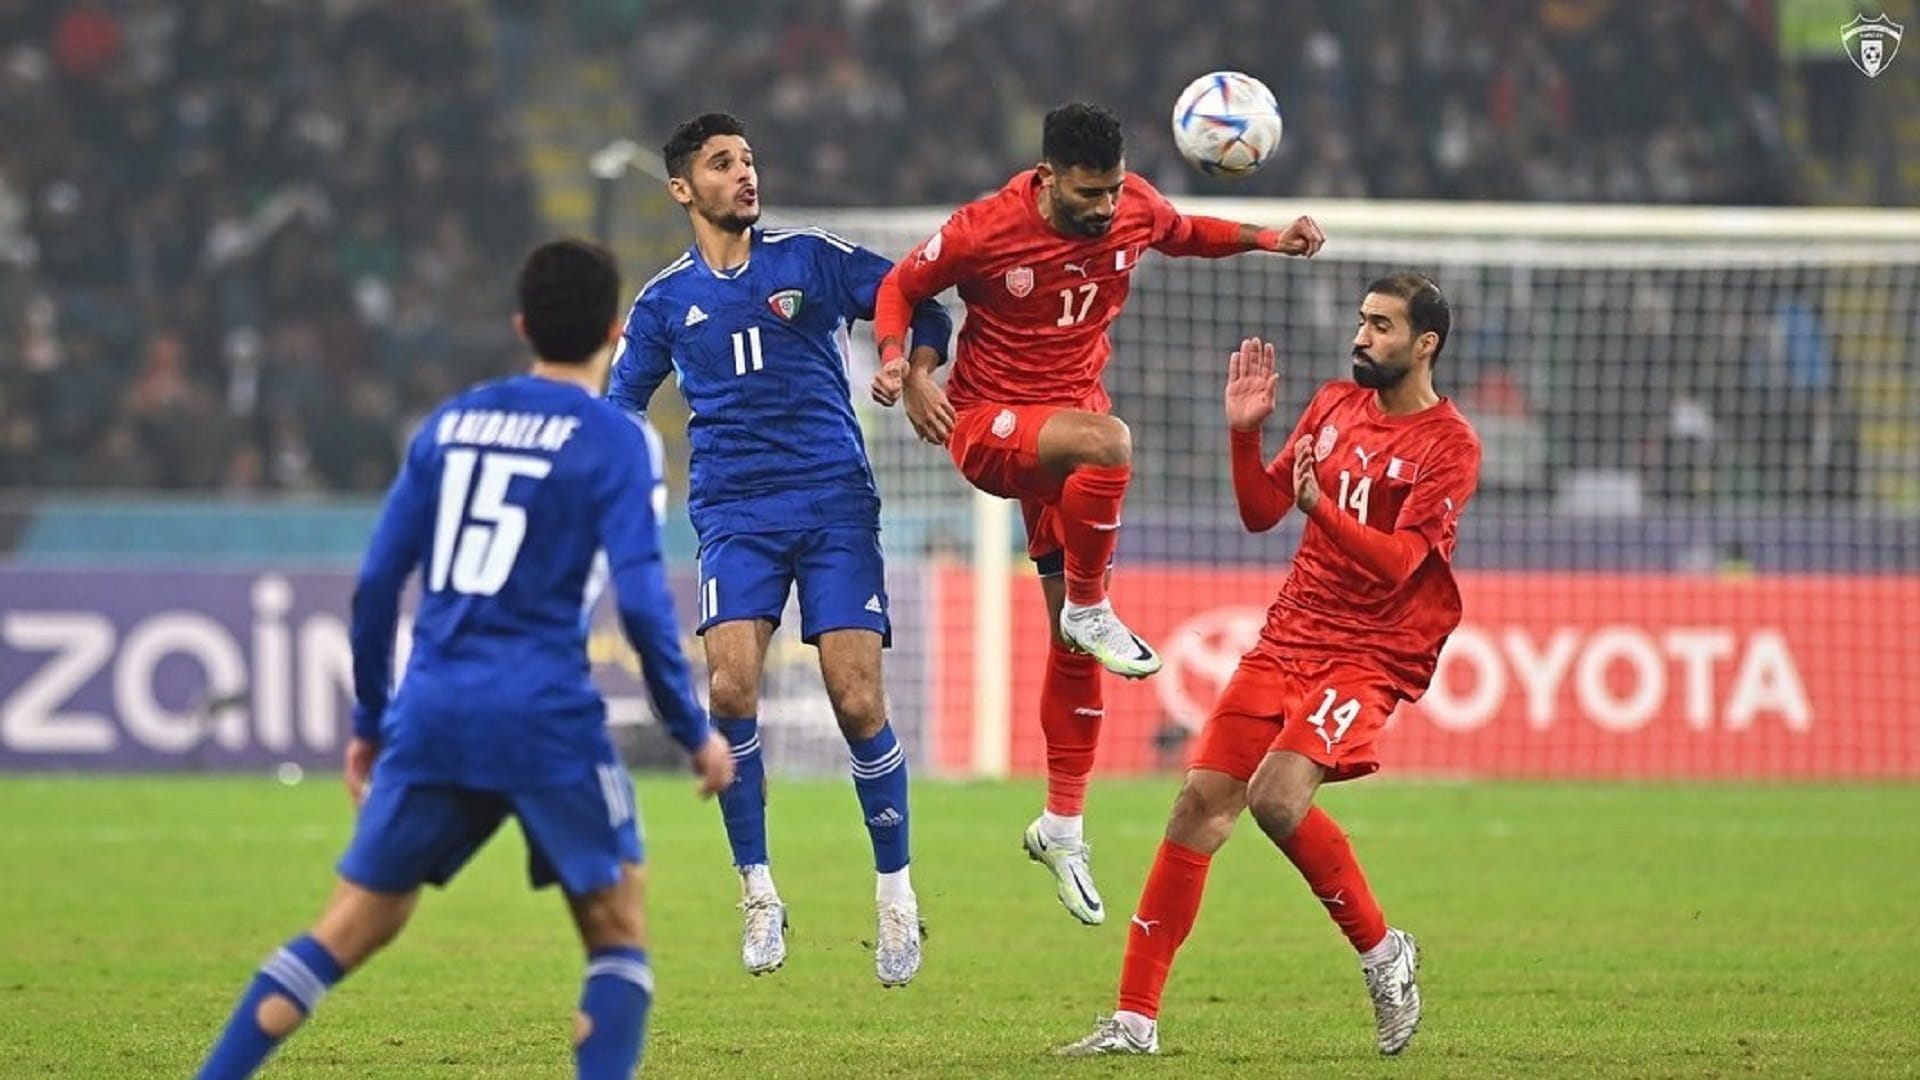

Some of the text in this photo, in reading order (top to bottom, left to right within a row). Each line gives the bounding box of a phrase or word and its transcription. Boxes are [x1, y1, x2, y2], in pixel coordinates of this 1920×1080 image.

[1057, 282, 1099, 327] 17
[731, 326, 764, 376] 11
[430, 449, 552, 597] 15
[1338, 470, 1373, 526] 14
[1421, 624, 1814, 732] OYOTA
[1306, 688, 1361, 741] 14
